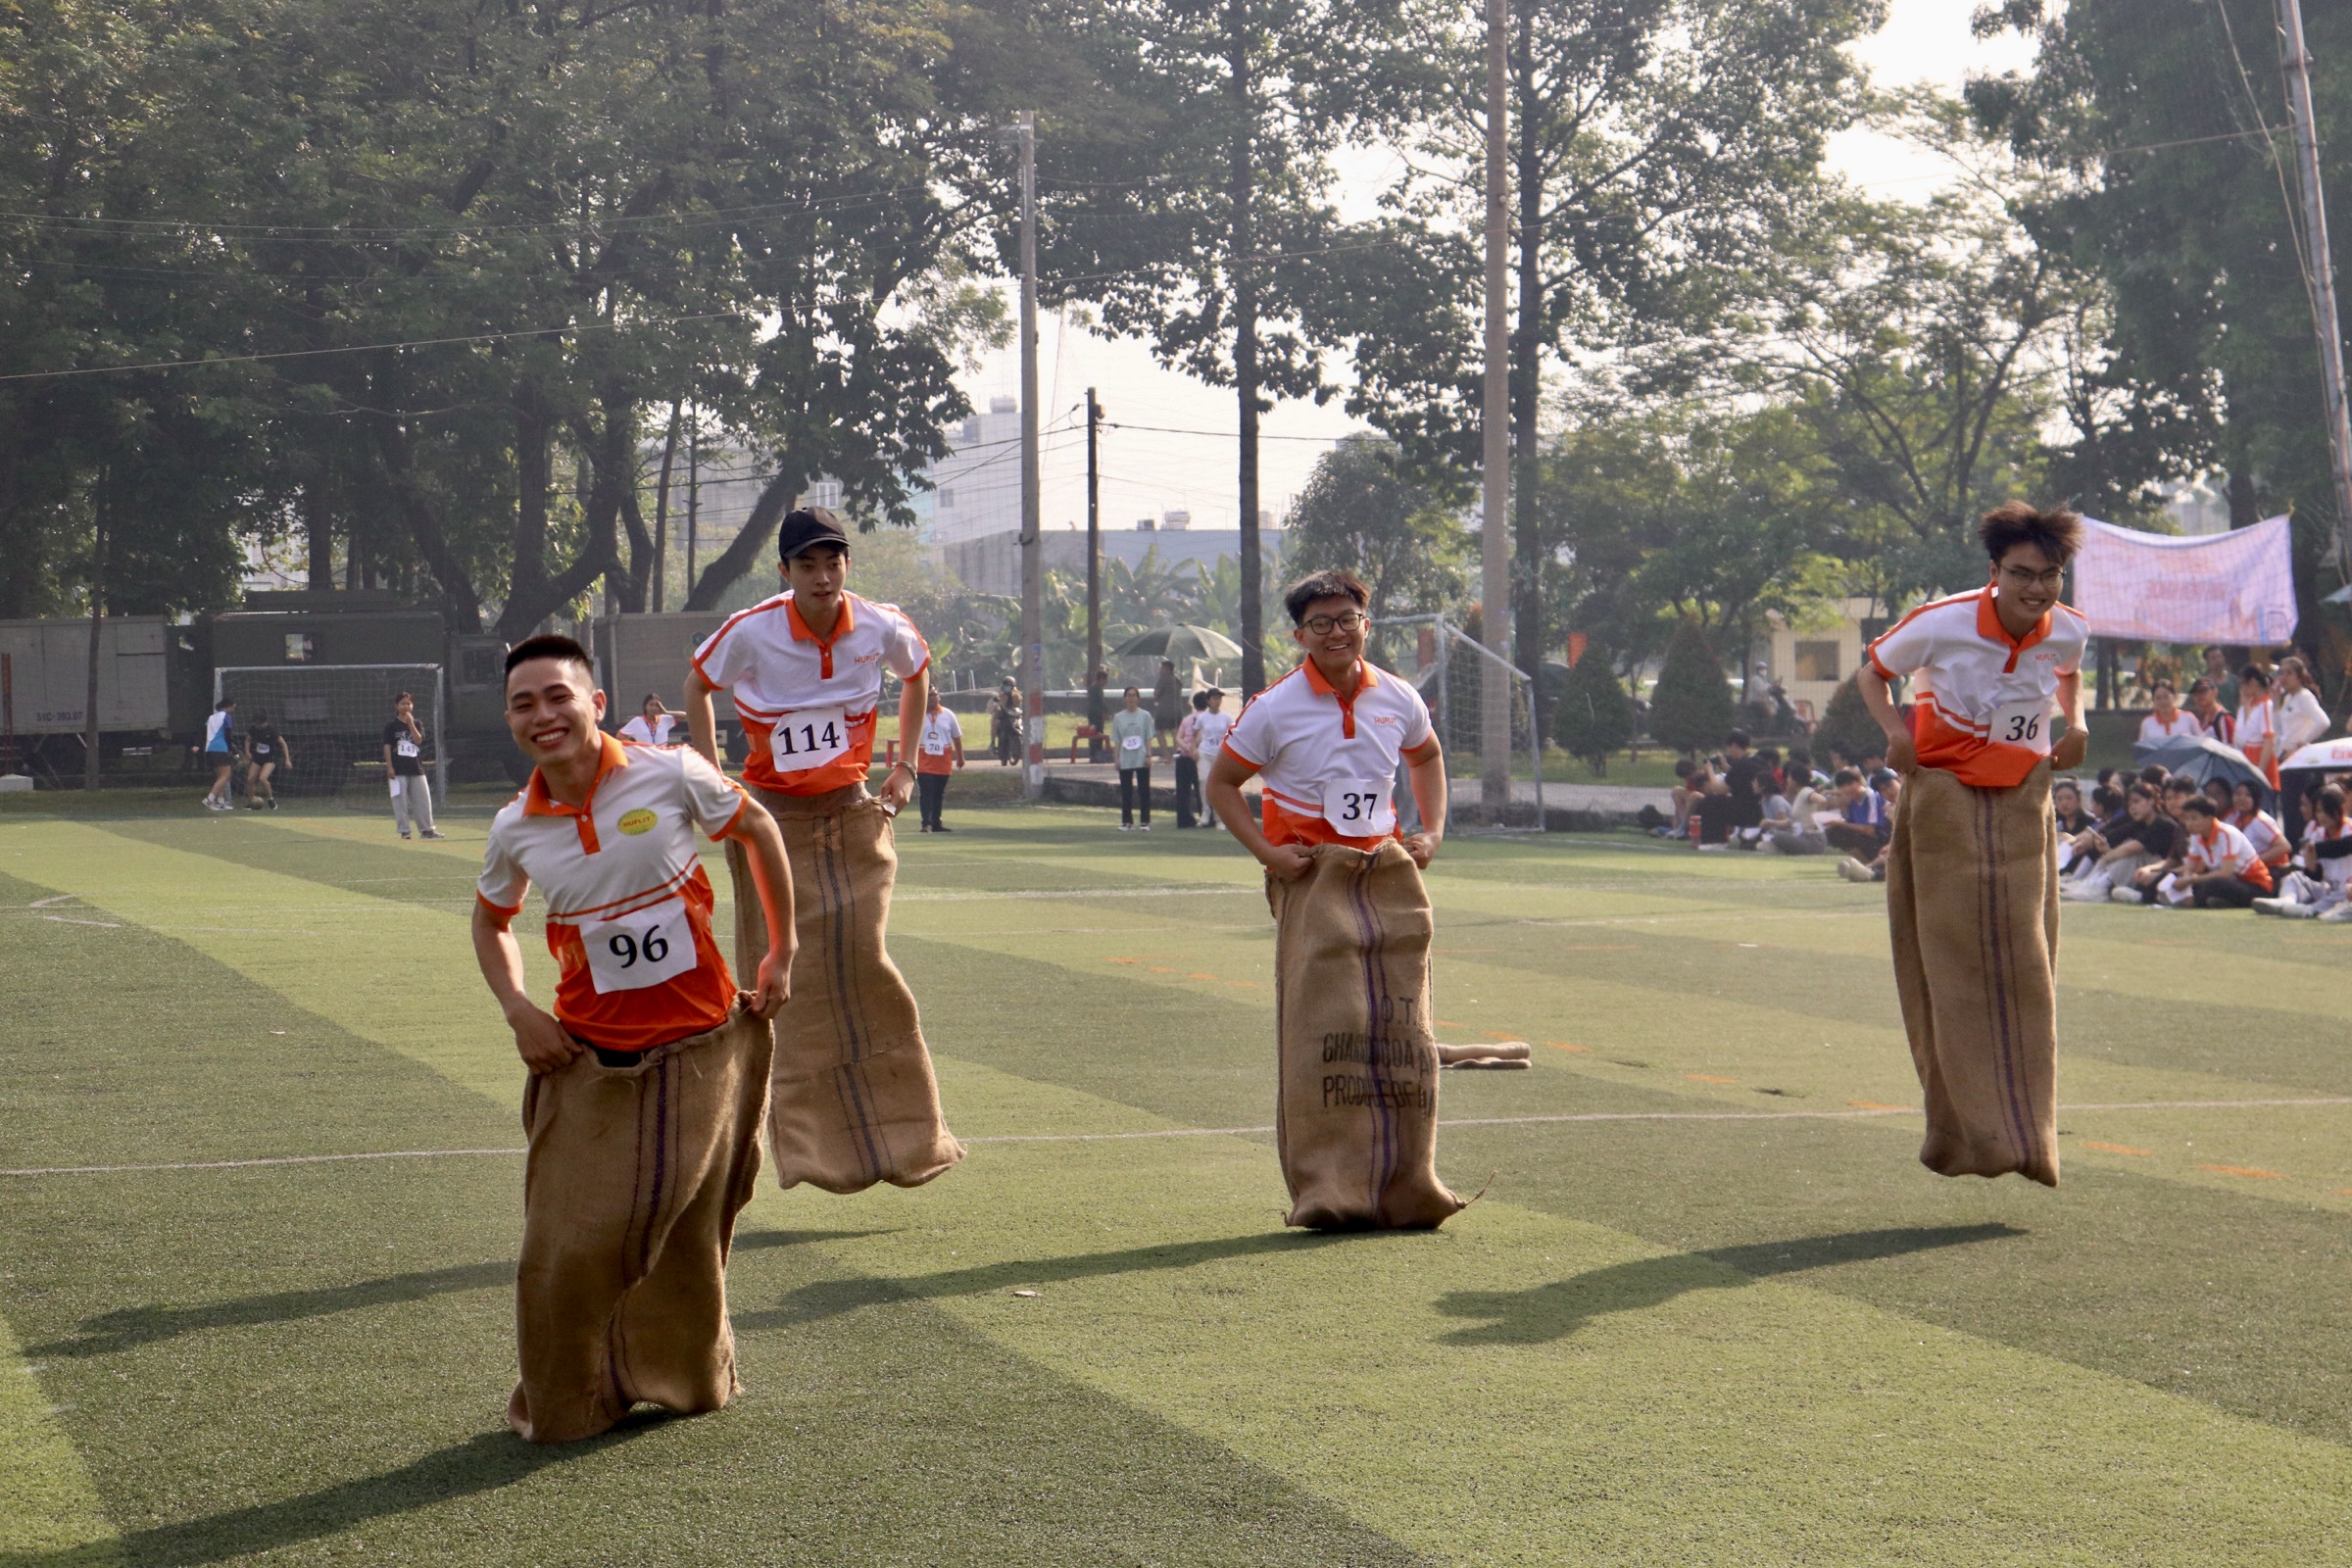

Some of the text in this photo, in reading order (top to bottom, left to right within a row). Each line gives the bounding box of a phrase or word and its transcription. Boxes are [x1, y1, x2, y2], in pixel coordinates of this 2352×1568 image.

[777, 720, 841, 756] 114
[2005, 713, 2040, 742] 36
[401, 745, 416, 754] 143
[929, 743, 940, 752] 70
[1342, 792, 1378, 821] 37
[622, 815, 651, 828] HUFLIT
[609, 924, 669, 969] 96
